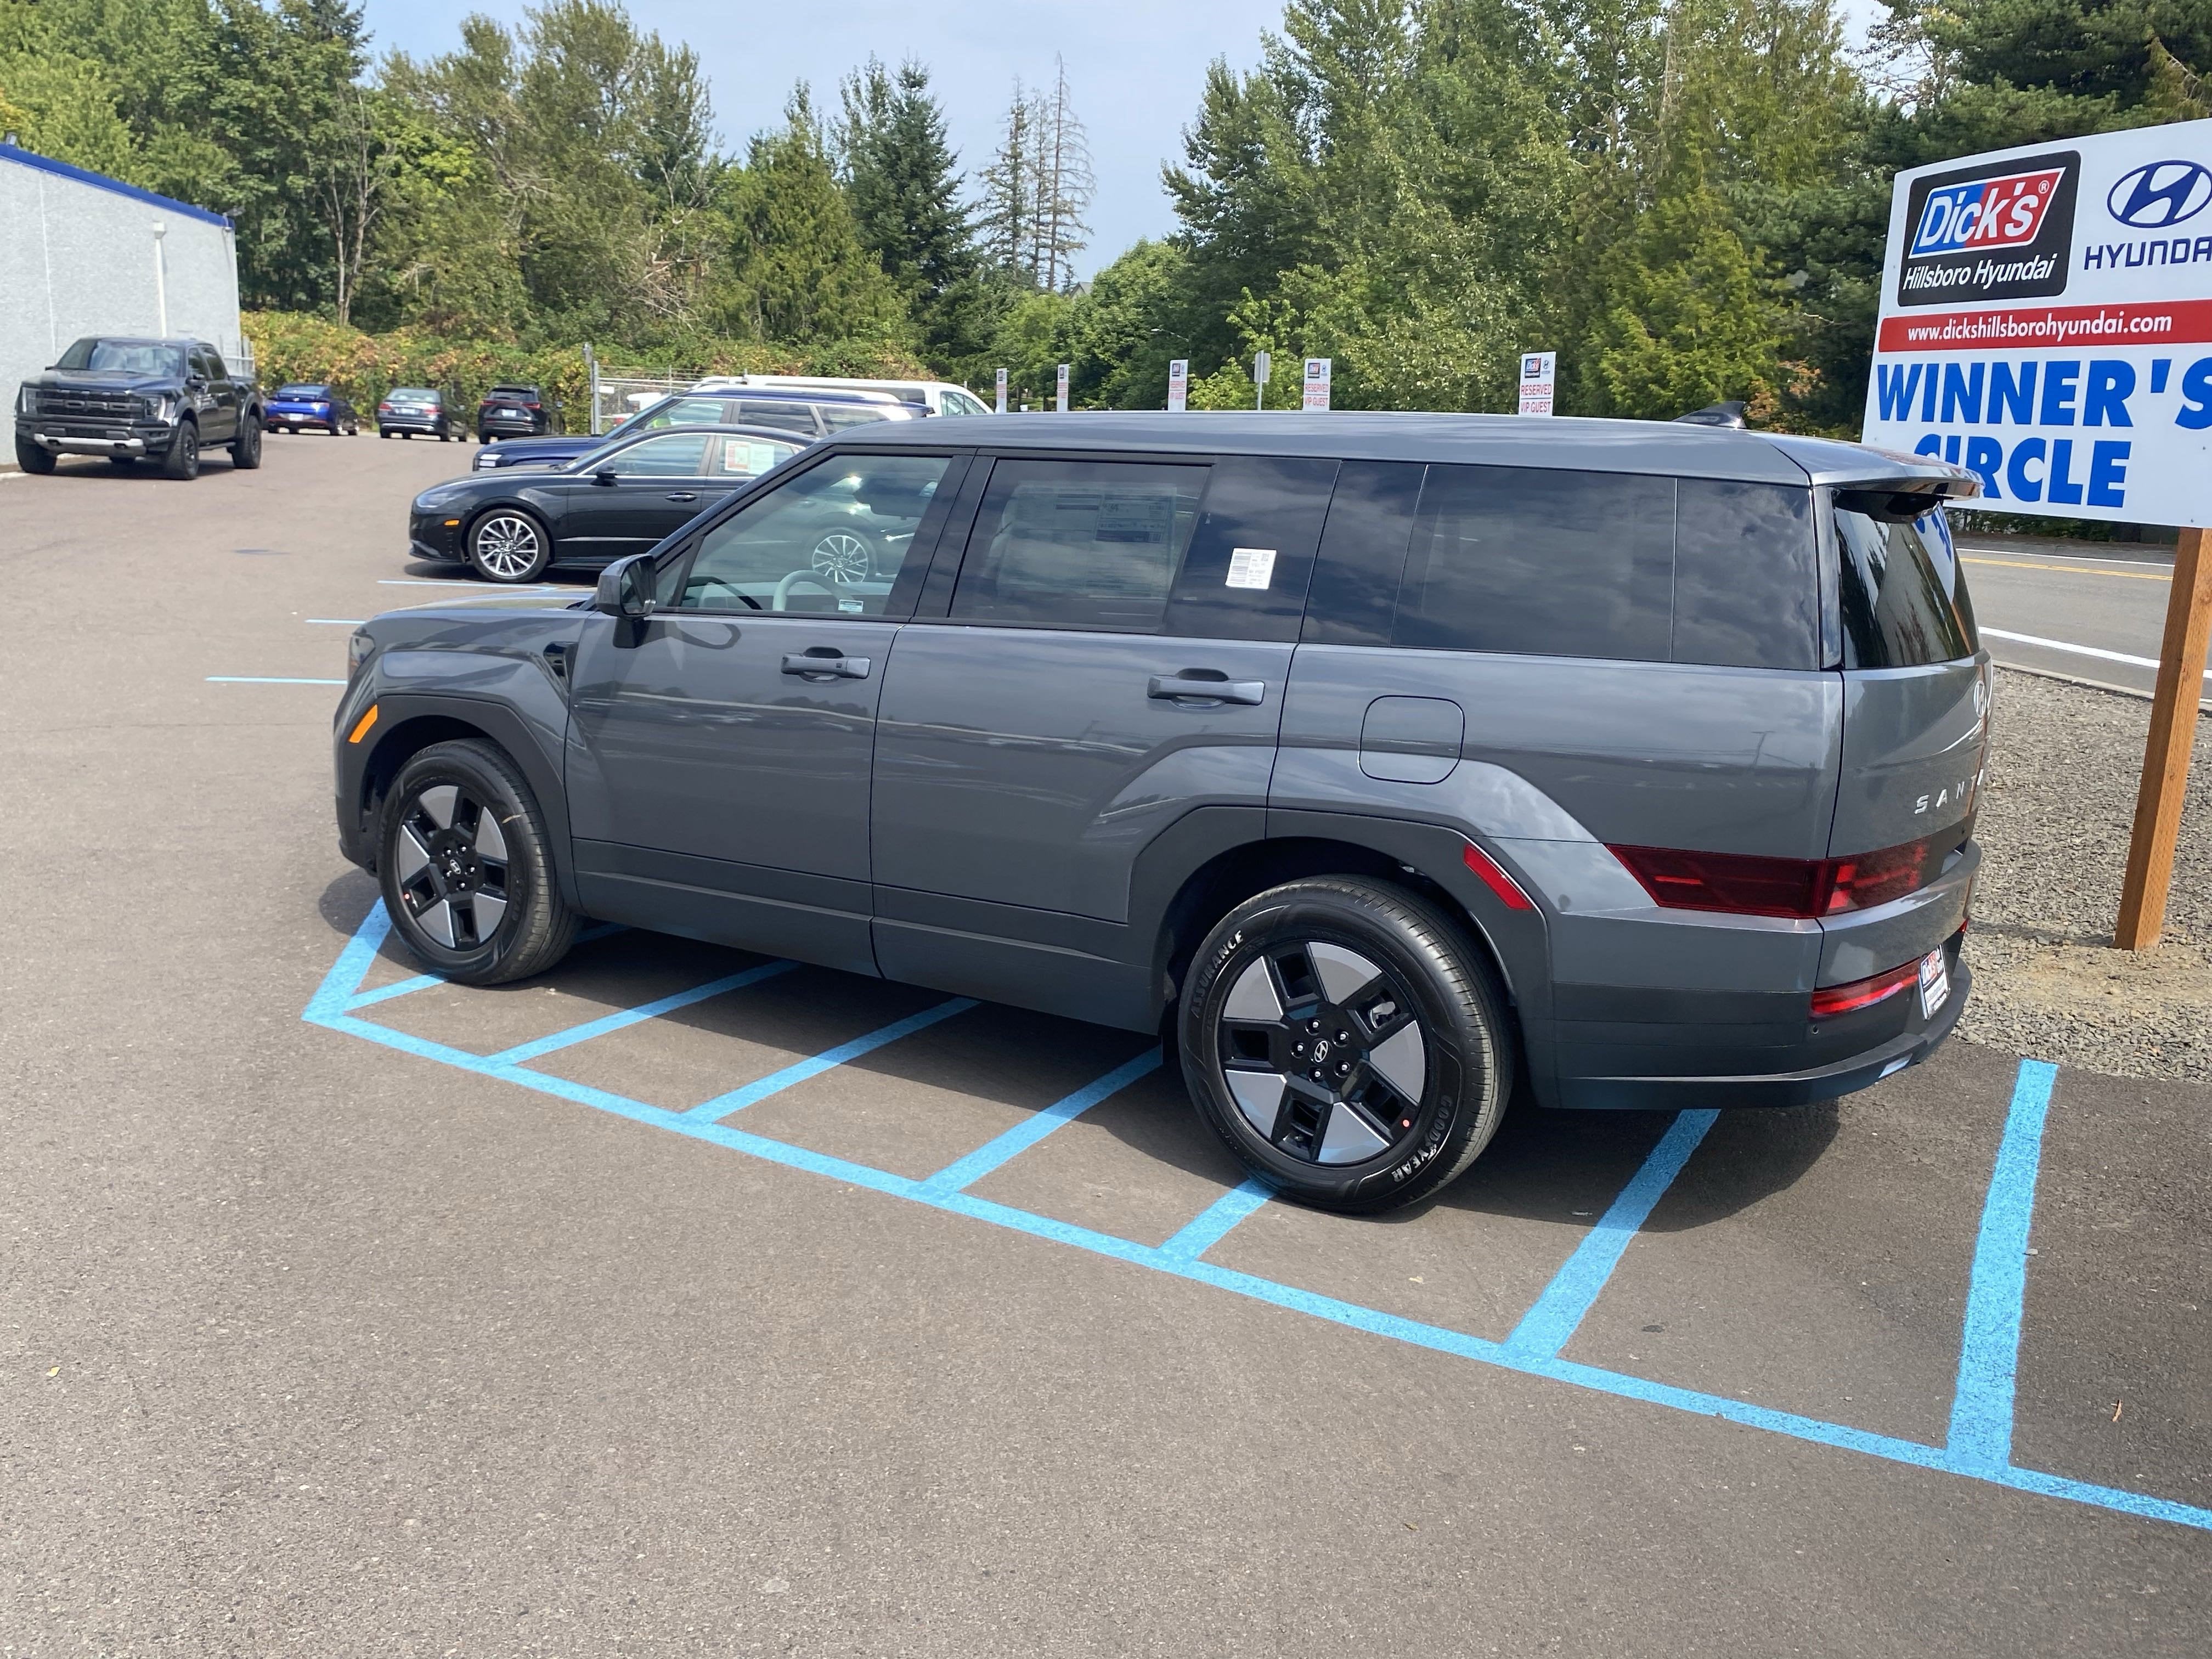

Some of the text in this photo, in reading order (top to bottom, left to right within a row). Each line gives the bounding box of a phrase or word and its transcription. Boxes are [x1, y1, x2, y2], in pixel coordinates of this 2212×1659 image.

[1918, 182, 2039, 247] Dick's
[1903, 253, 2058, 290] Hillsboro Hyundai
[1908, 310, 2172, 342] www.dickshillsborohyundai.com
[1305, 383, 1329, 393] RESERVED
[1521, 384, 1552, 396] RESERVED
[1313, 397, 1329, 406] GUEST
[1521, 402, 1551, 413] VIP GUEST
